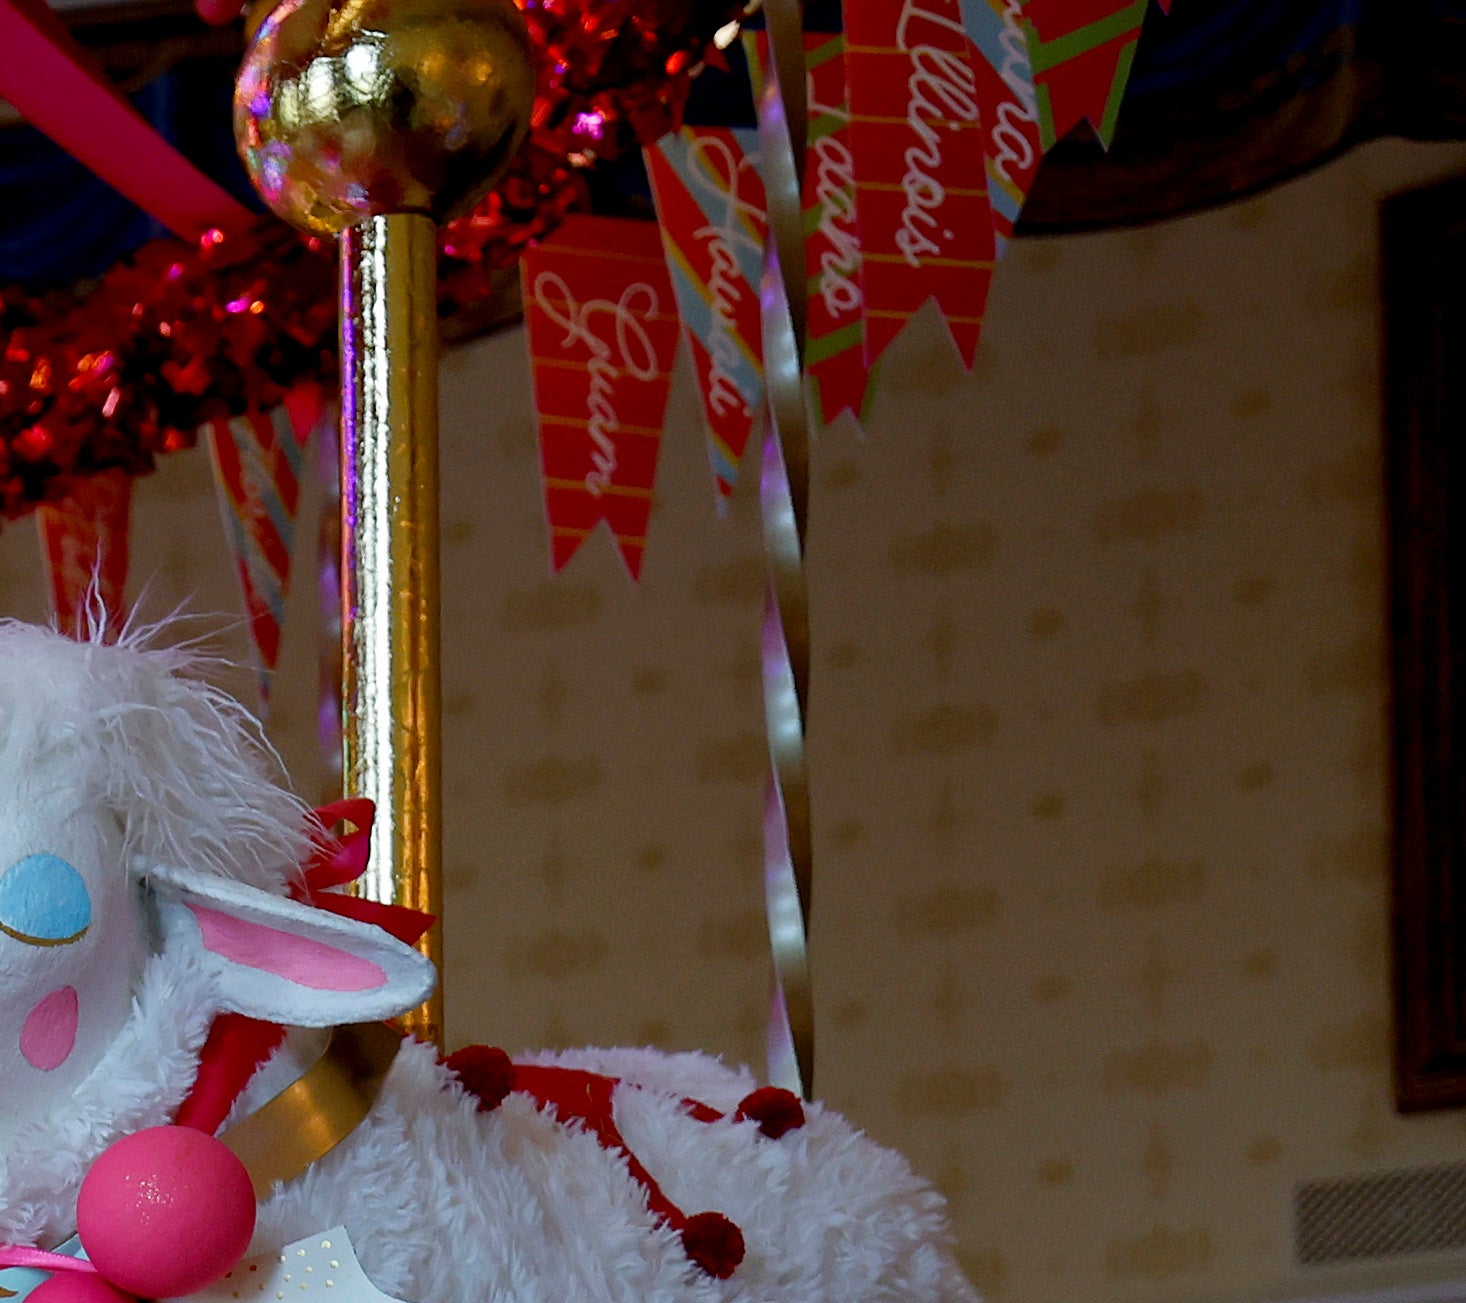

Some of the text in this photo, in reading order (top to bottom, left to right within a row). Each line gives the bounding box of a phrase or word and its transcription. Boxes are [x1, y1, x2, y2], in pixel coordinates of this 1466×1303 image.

[894, 0, 978, 268] Illinois
[534, 270, 660, 496] Guam
[687, 136, 766, 415] Hawaii
